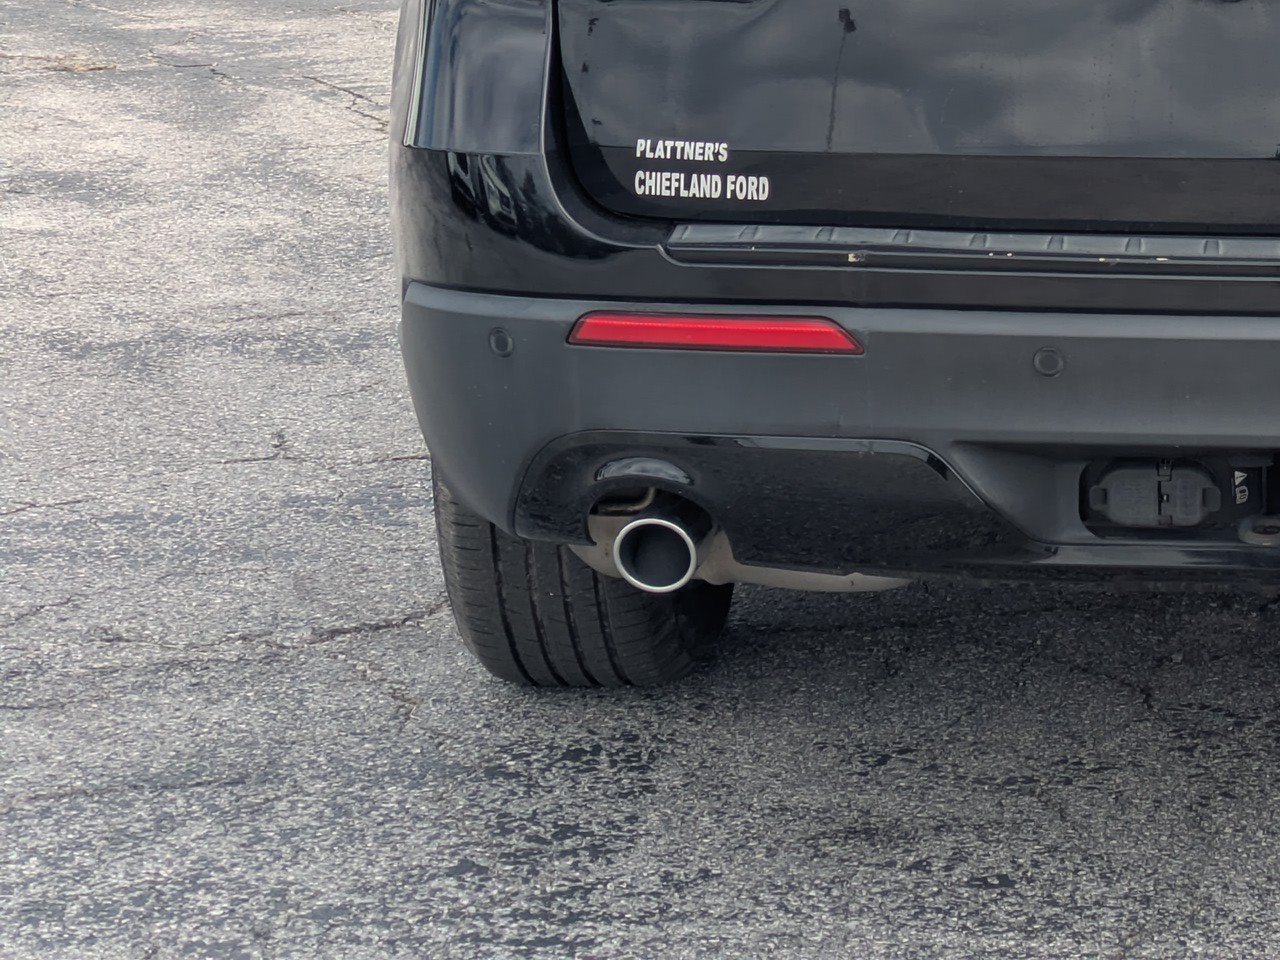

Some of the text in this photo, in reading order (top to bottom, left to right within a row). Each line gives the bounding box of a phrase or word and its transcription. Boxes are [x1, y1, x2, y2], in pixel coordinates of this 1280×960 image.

[635, 138, 729, 163] PLATTNER'S
[634, 170, 770, 201] CHIEFLAND FORD
